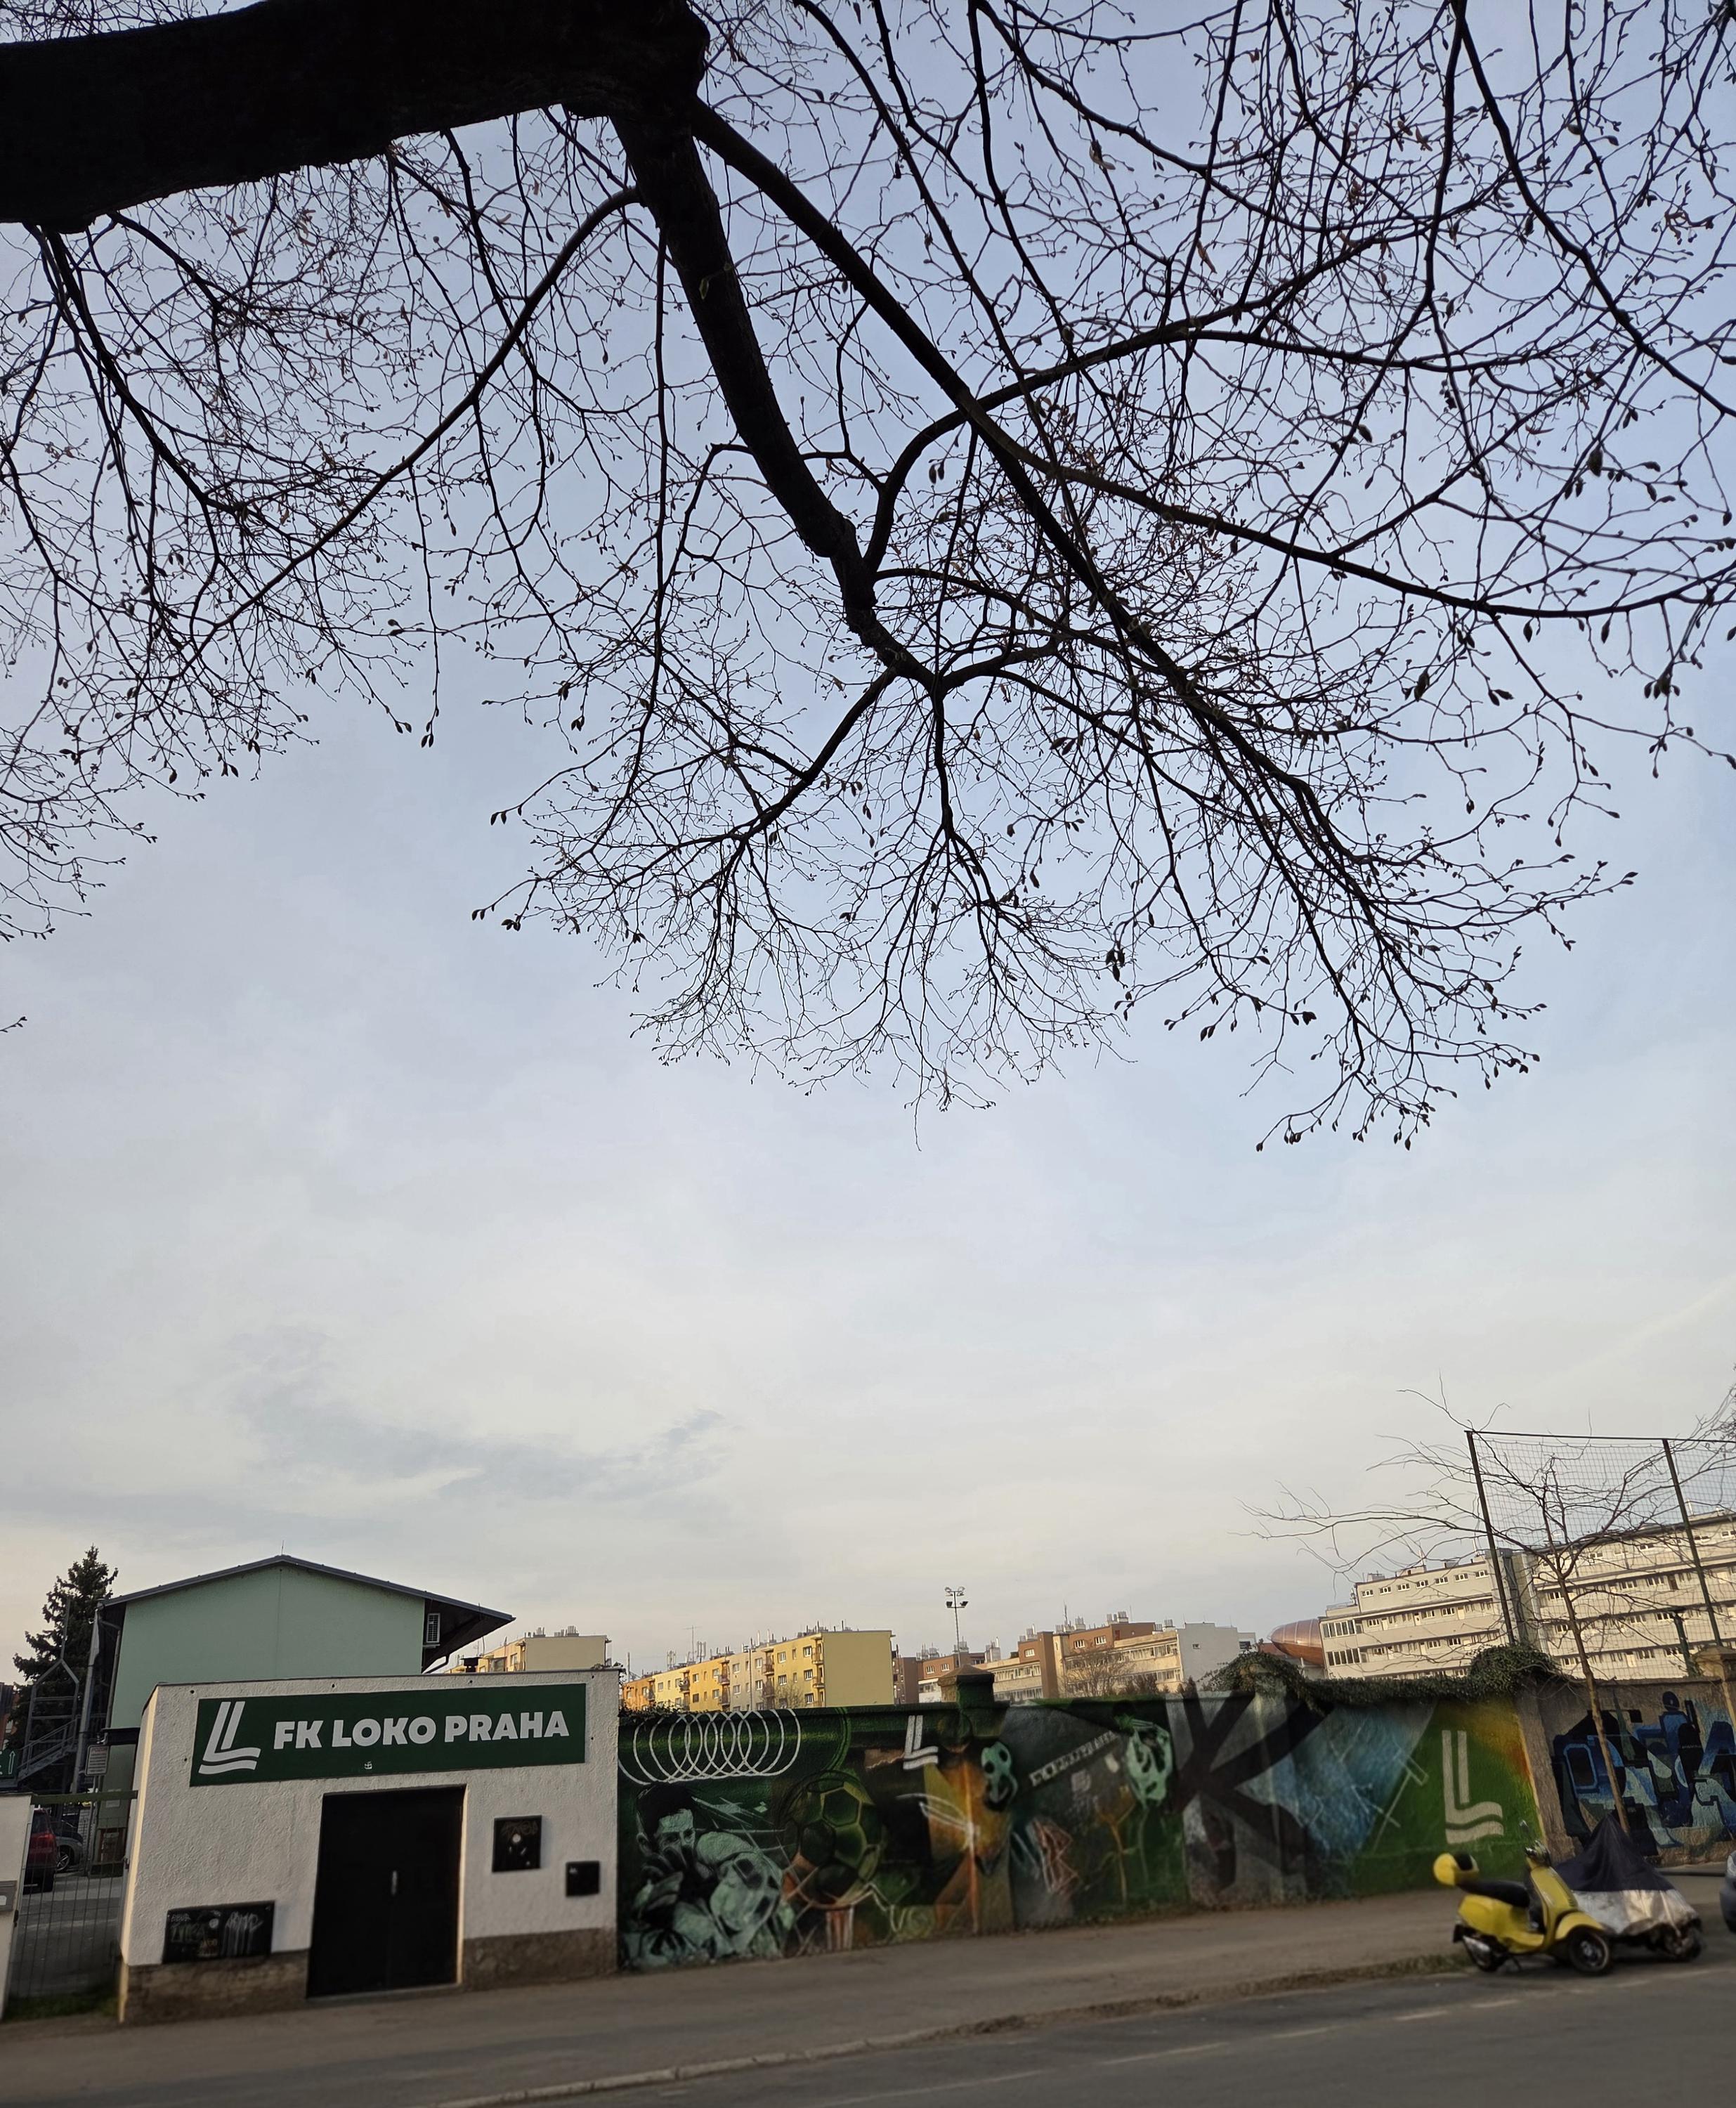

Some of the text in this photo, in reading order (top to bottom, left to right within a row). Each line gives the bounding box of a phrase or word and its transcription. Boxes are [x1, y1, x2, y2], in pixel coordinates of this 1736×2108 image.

[273, 1710, 570, 1750] FK LOKO PRAHA
